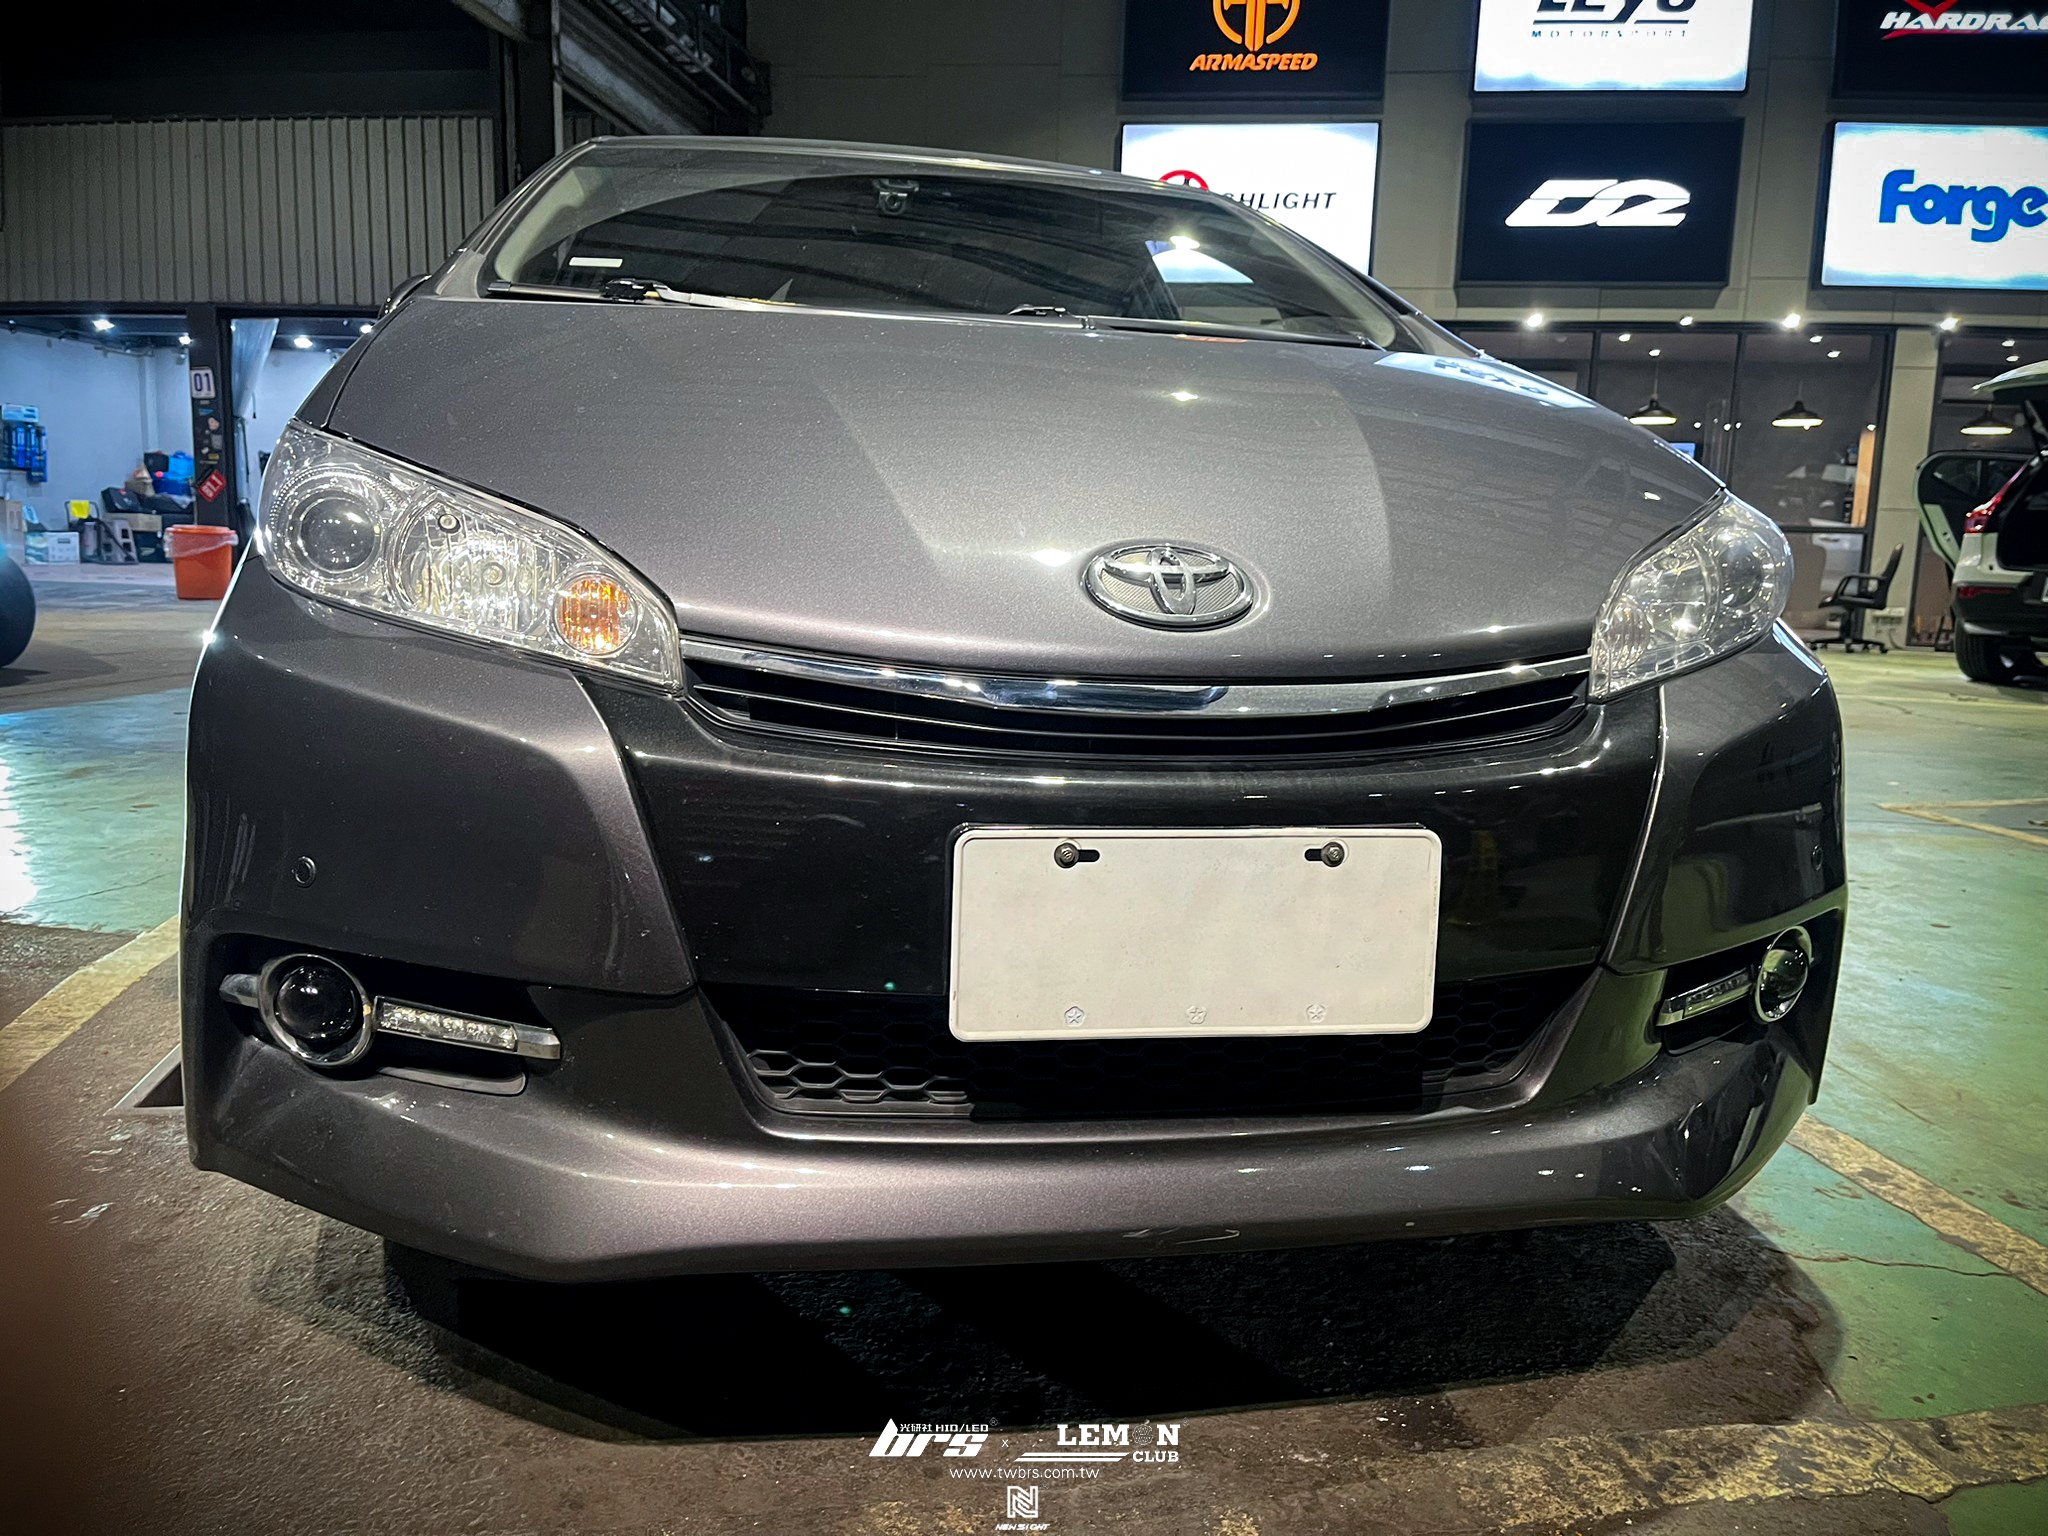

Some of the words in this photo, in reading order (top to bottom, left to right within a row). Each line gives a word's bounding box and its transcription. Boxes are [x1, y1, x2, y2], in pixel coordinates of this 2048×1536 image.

[1189, 53, 1318, 71] ARMASPEED
[1505, 179, 1691, 227] D2
[194, 372, 211, 392] 01
